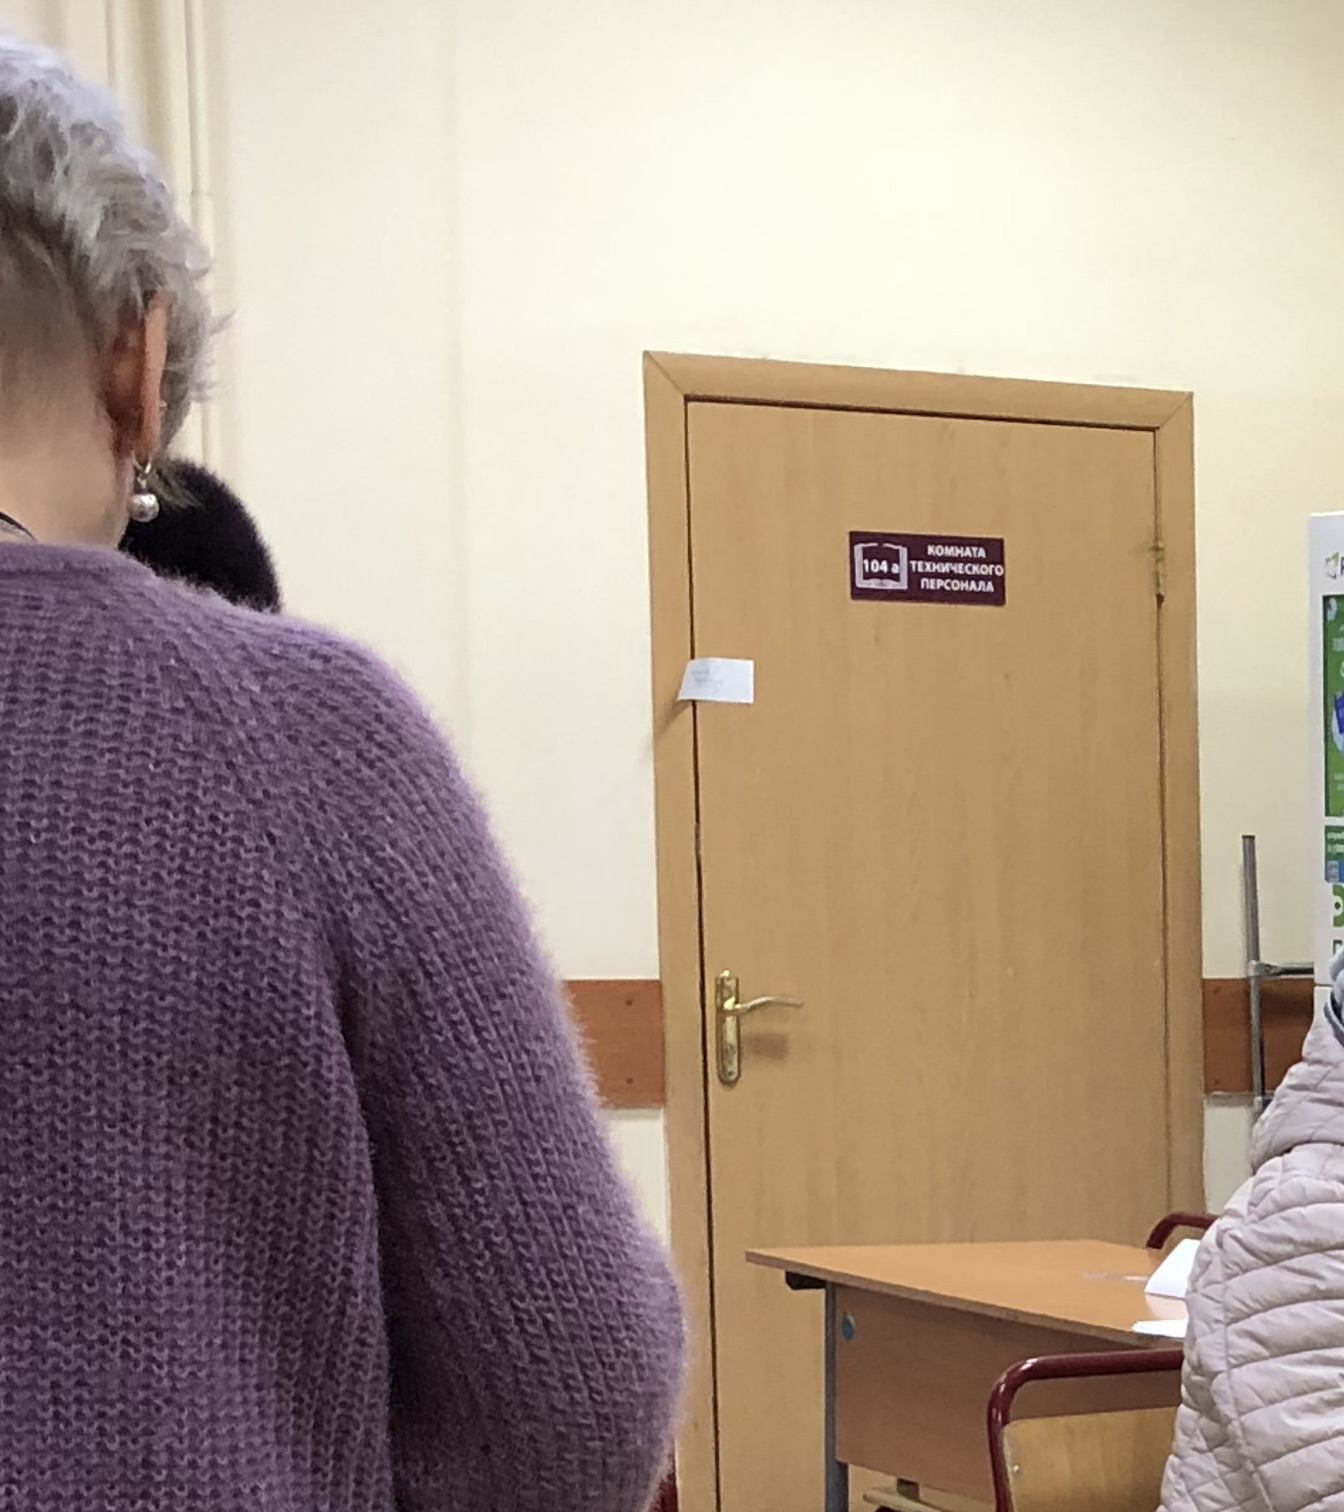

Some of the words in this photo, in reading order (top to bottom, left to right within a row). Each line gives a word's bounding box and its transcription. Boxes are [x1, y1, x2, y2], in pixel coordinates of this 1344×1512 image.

[927, 545, 986, 558] КОМНАТА
[863, 559, 888, 573] 104
[910, 561, 1004, 576] ТЕХНИЧЕСКОГО
[920, 578, 995, 593] ПЕРСОНАЛА
